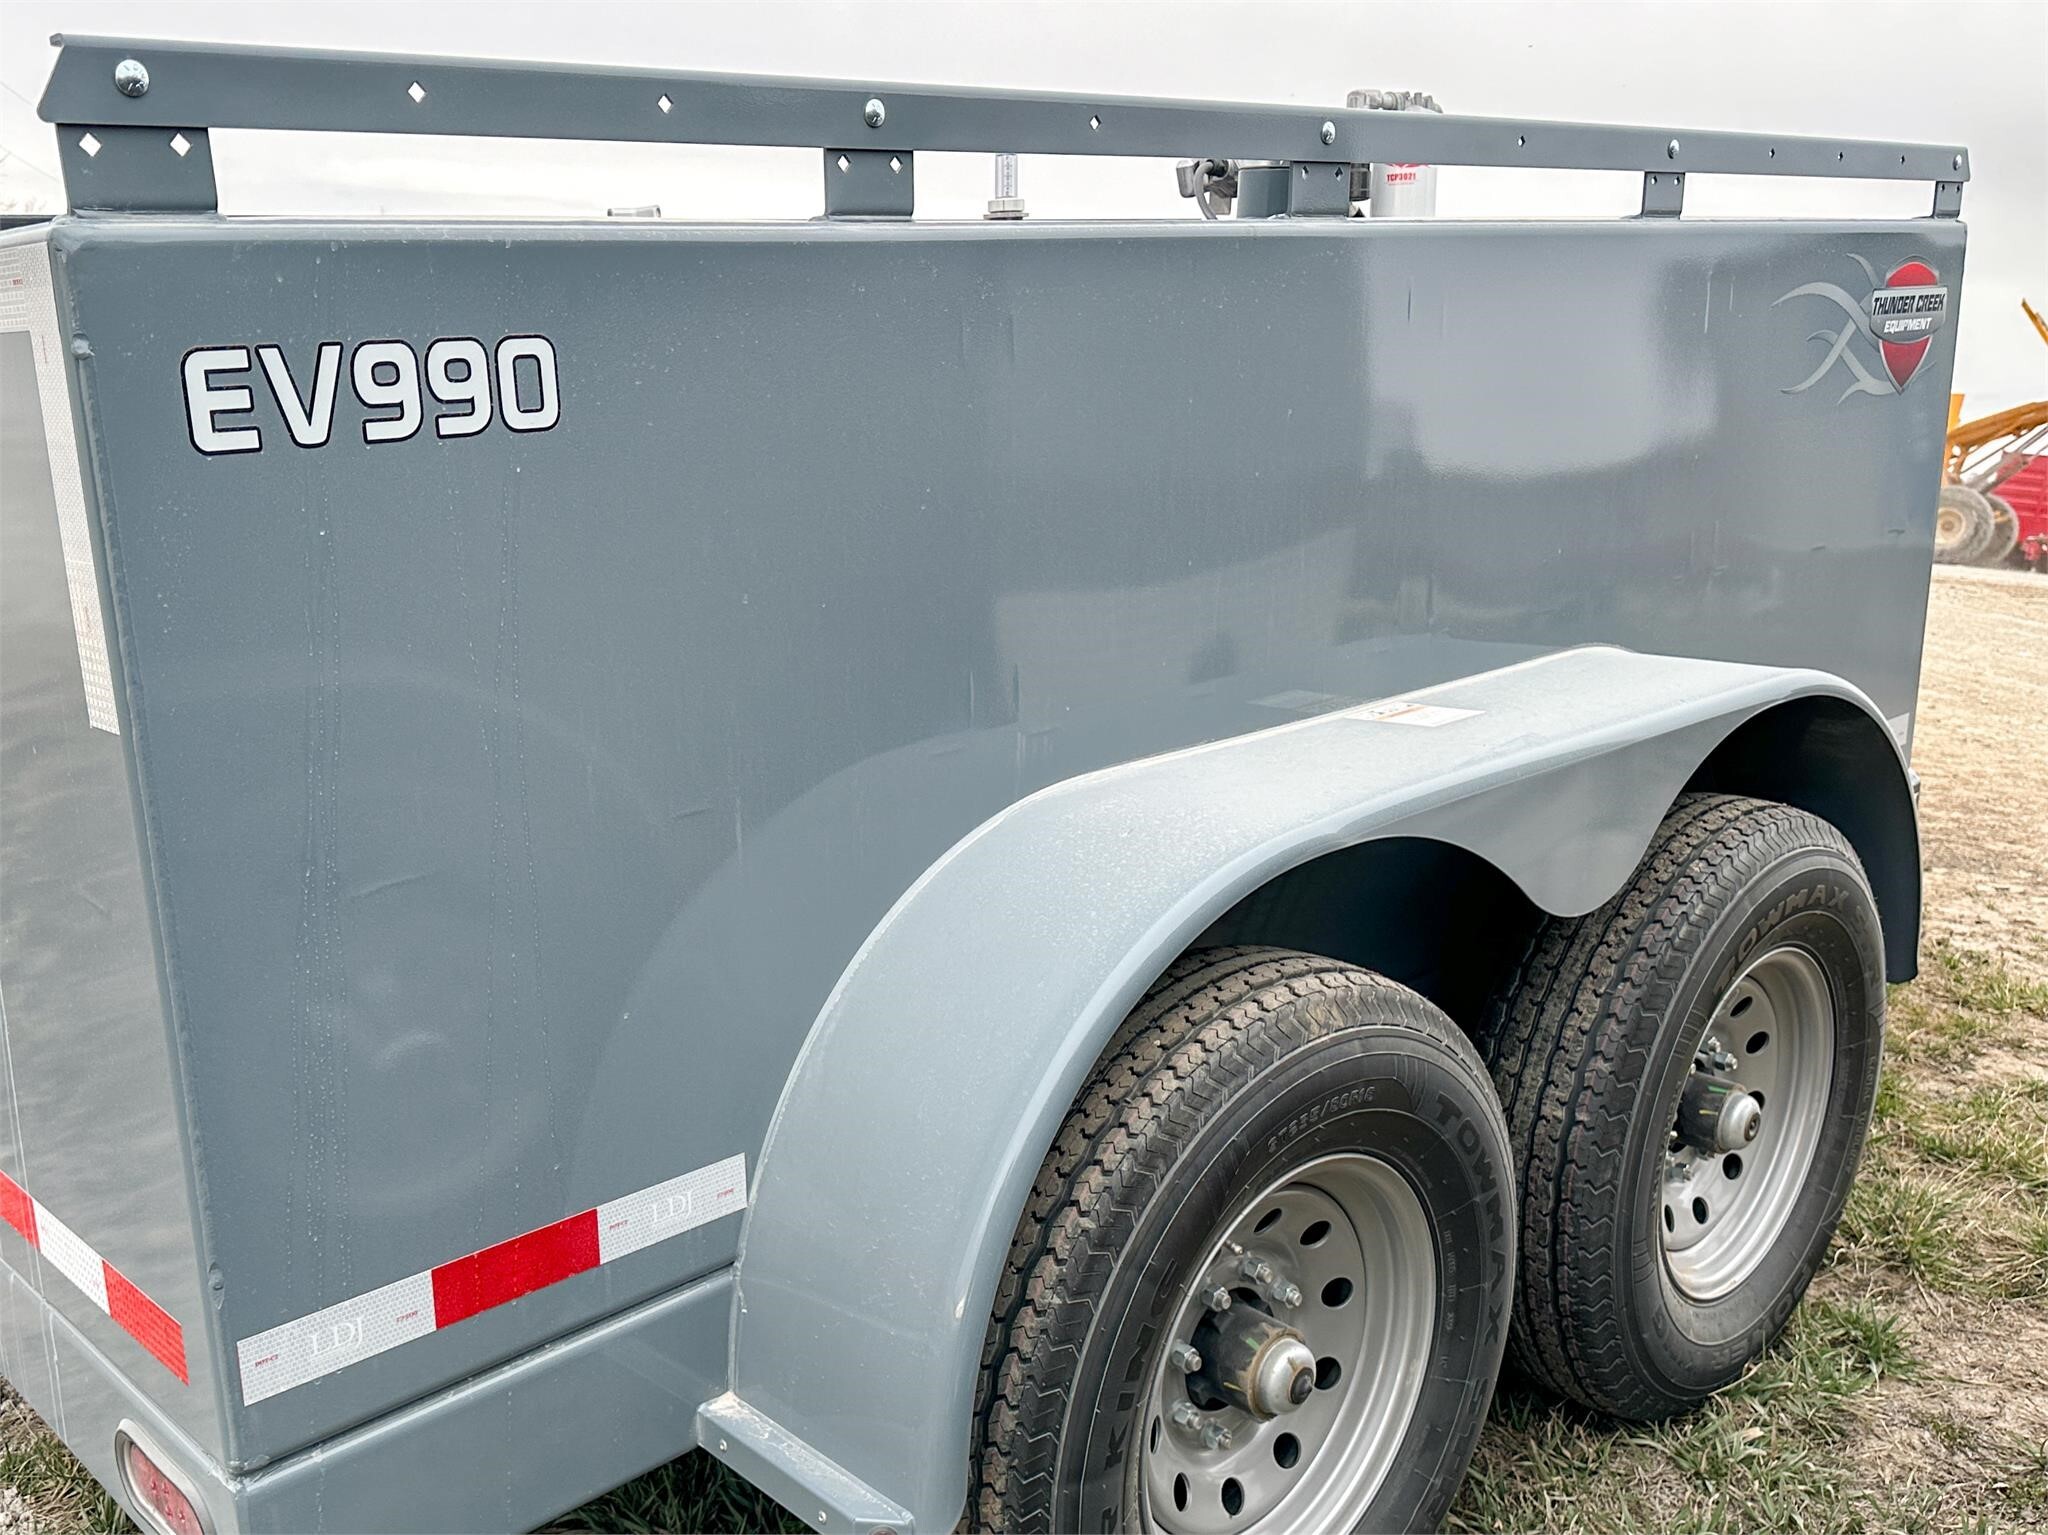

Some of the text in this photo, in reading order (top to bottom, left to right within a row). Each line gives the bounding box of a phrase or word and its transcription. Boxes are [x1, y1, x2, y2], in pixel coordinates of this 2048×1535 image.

[1386, 172, 1416, 182] TCP3021
[1872, 293, 1946, 316] THUNDER CREEK
[1883, 317, 1933, 334] EQUIPMENT
[182, 334, 560, 456] EV990
[1712, 884, 1849, 996] TOWMAX
[652, 1190, 696, 1223] LDJ
[1437, 1090, 1506, 1347] TOWMAX
[309, 1316, 365, 1356] LDJ
[1104, 1257, 1178, 1471] KING
